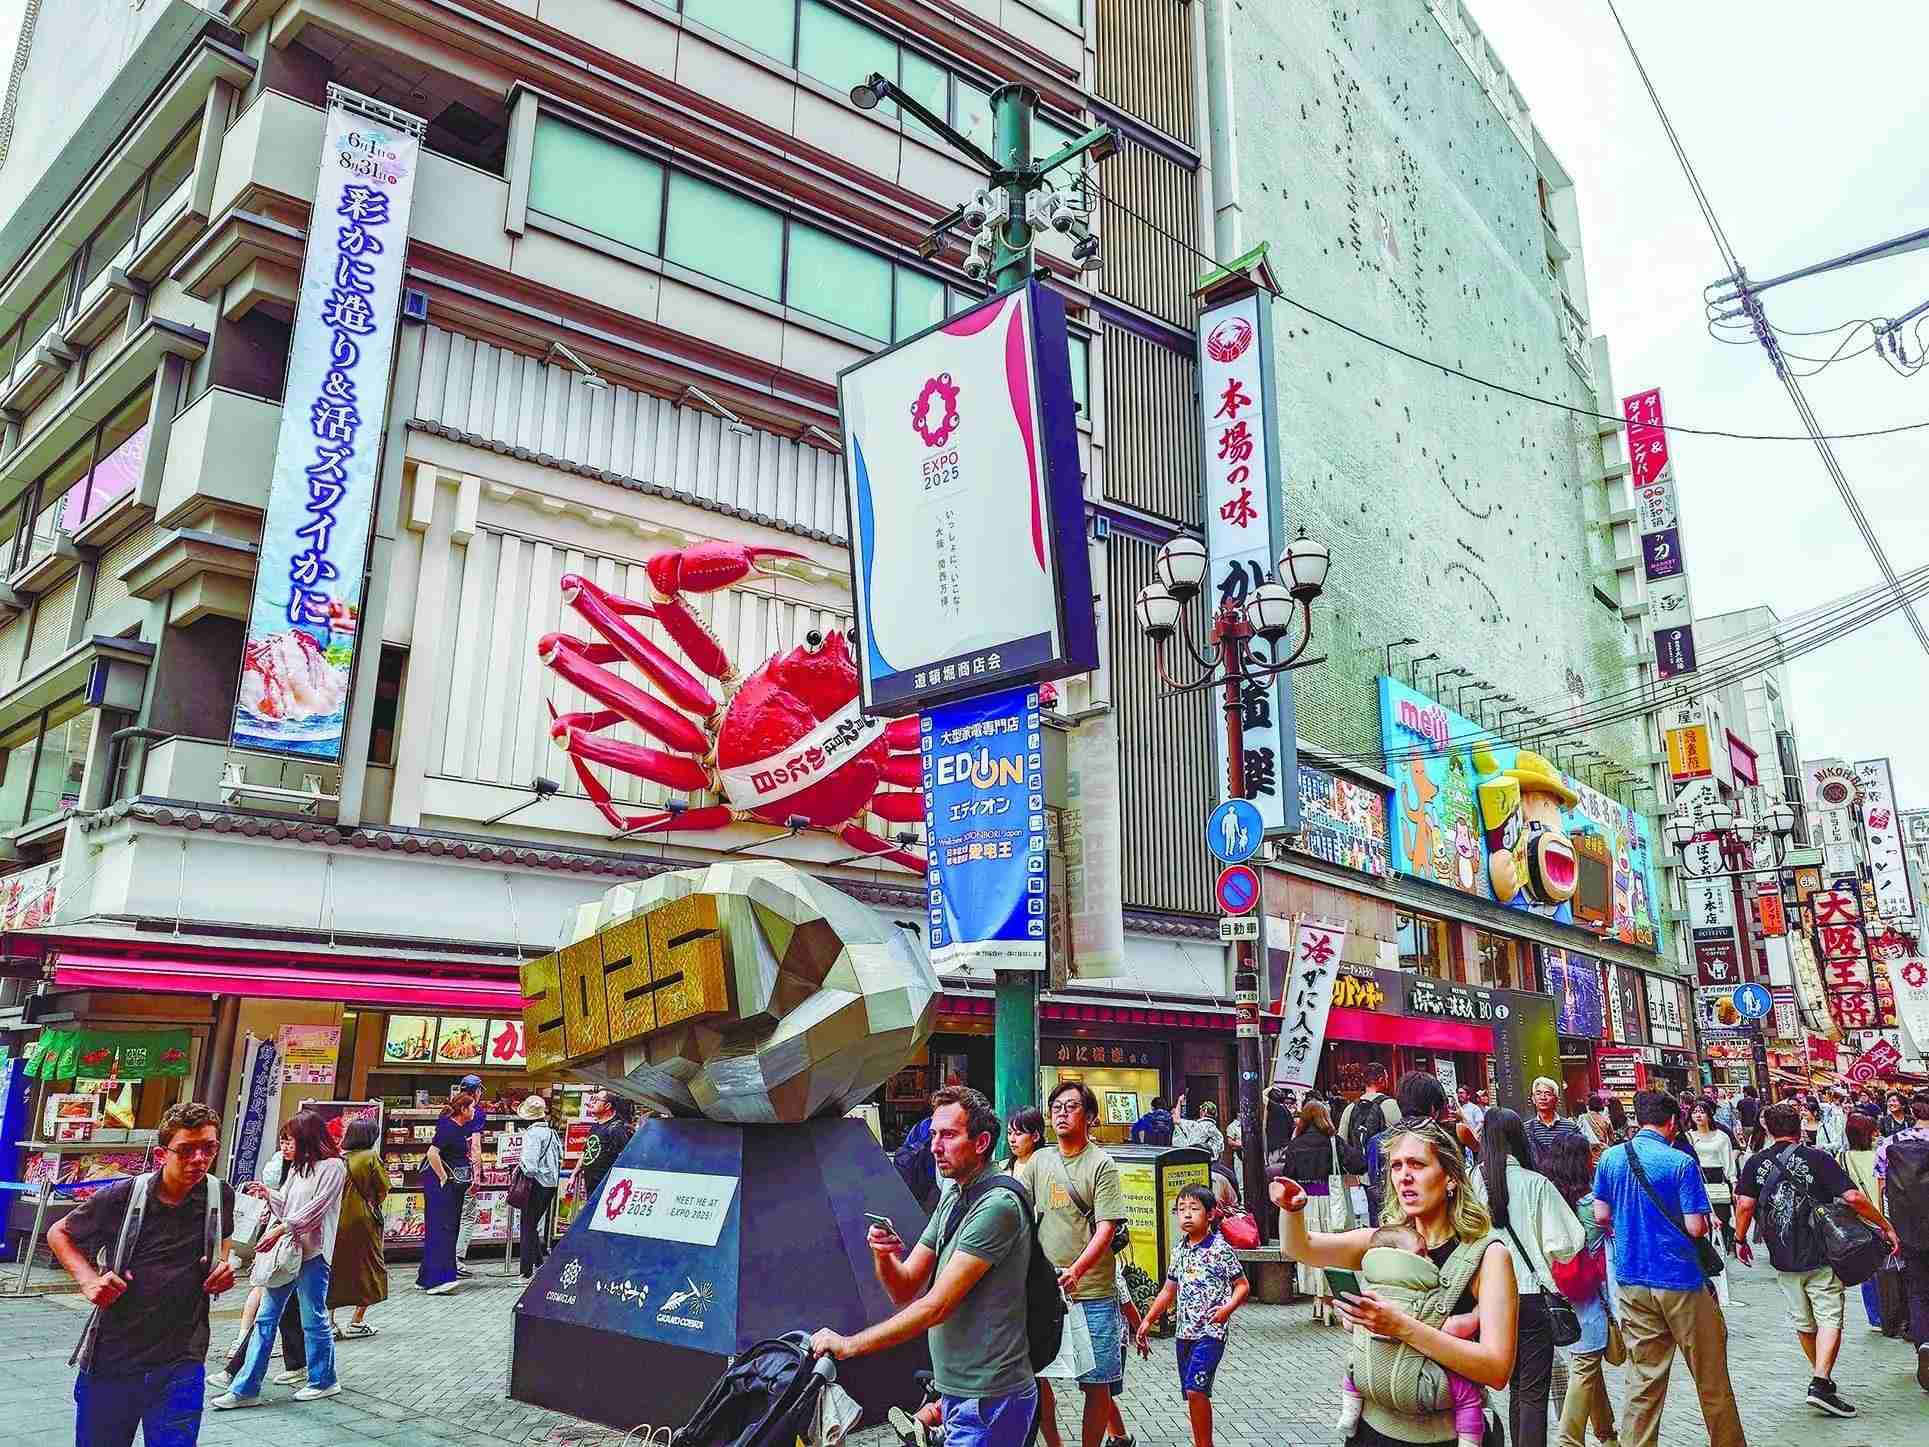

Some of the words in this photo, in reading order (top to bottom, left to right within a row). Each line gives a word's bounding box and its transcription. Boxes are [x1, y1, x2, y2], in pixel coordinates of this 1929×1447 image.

[923, 452, 959, 476] EXPO
[1214, 378, 1260, 528] 本場の味
[925, 466, 959, 490] 2025
[914, 653, 1001, 689] 道頓堀商店会
[1400, 700, 1449, 751] meiji
[949, 796, 1011, 823] エディオン
[1221, 923, 1257, 937] 自動車
[520, 894, 728, 1073] 2025
[627, 1203, 653, 1216] 2025
[632, 1191, 657, 1204] EXPO
